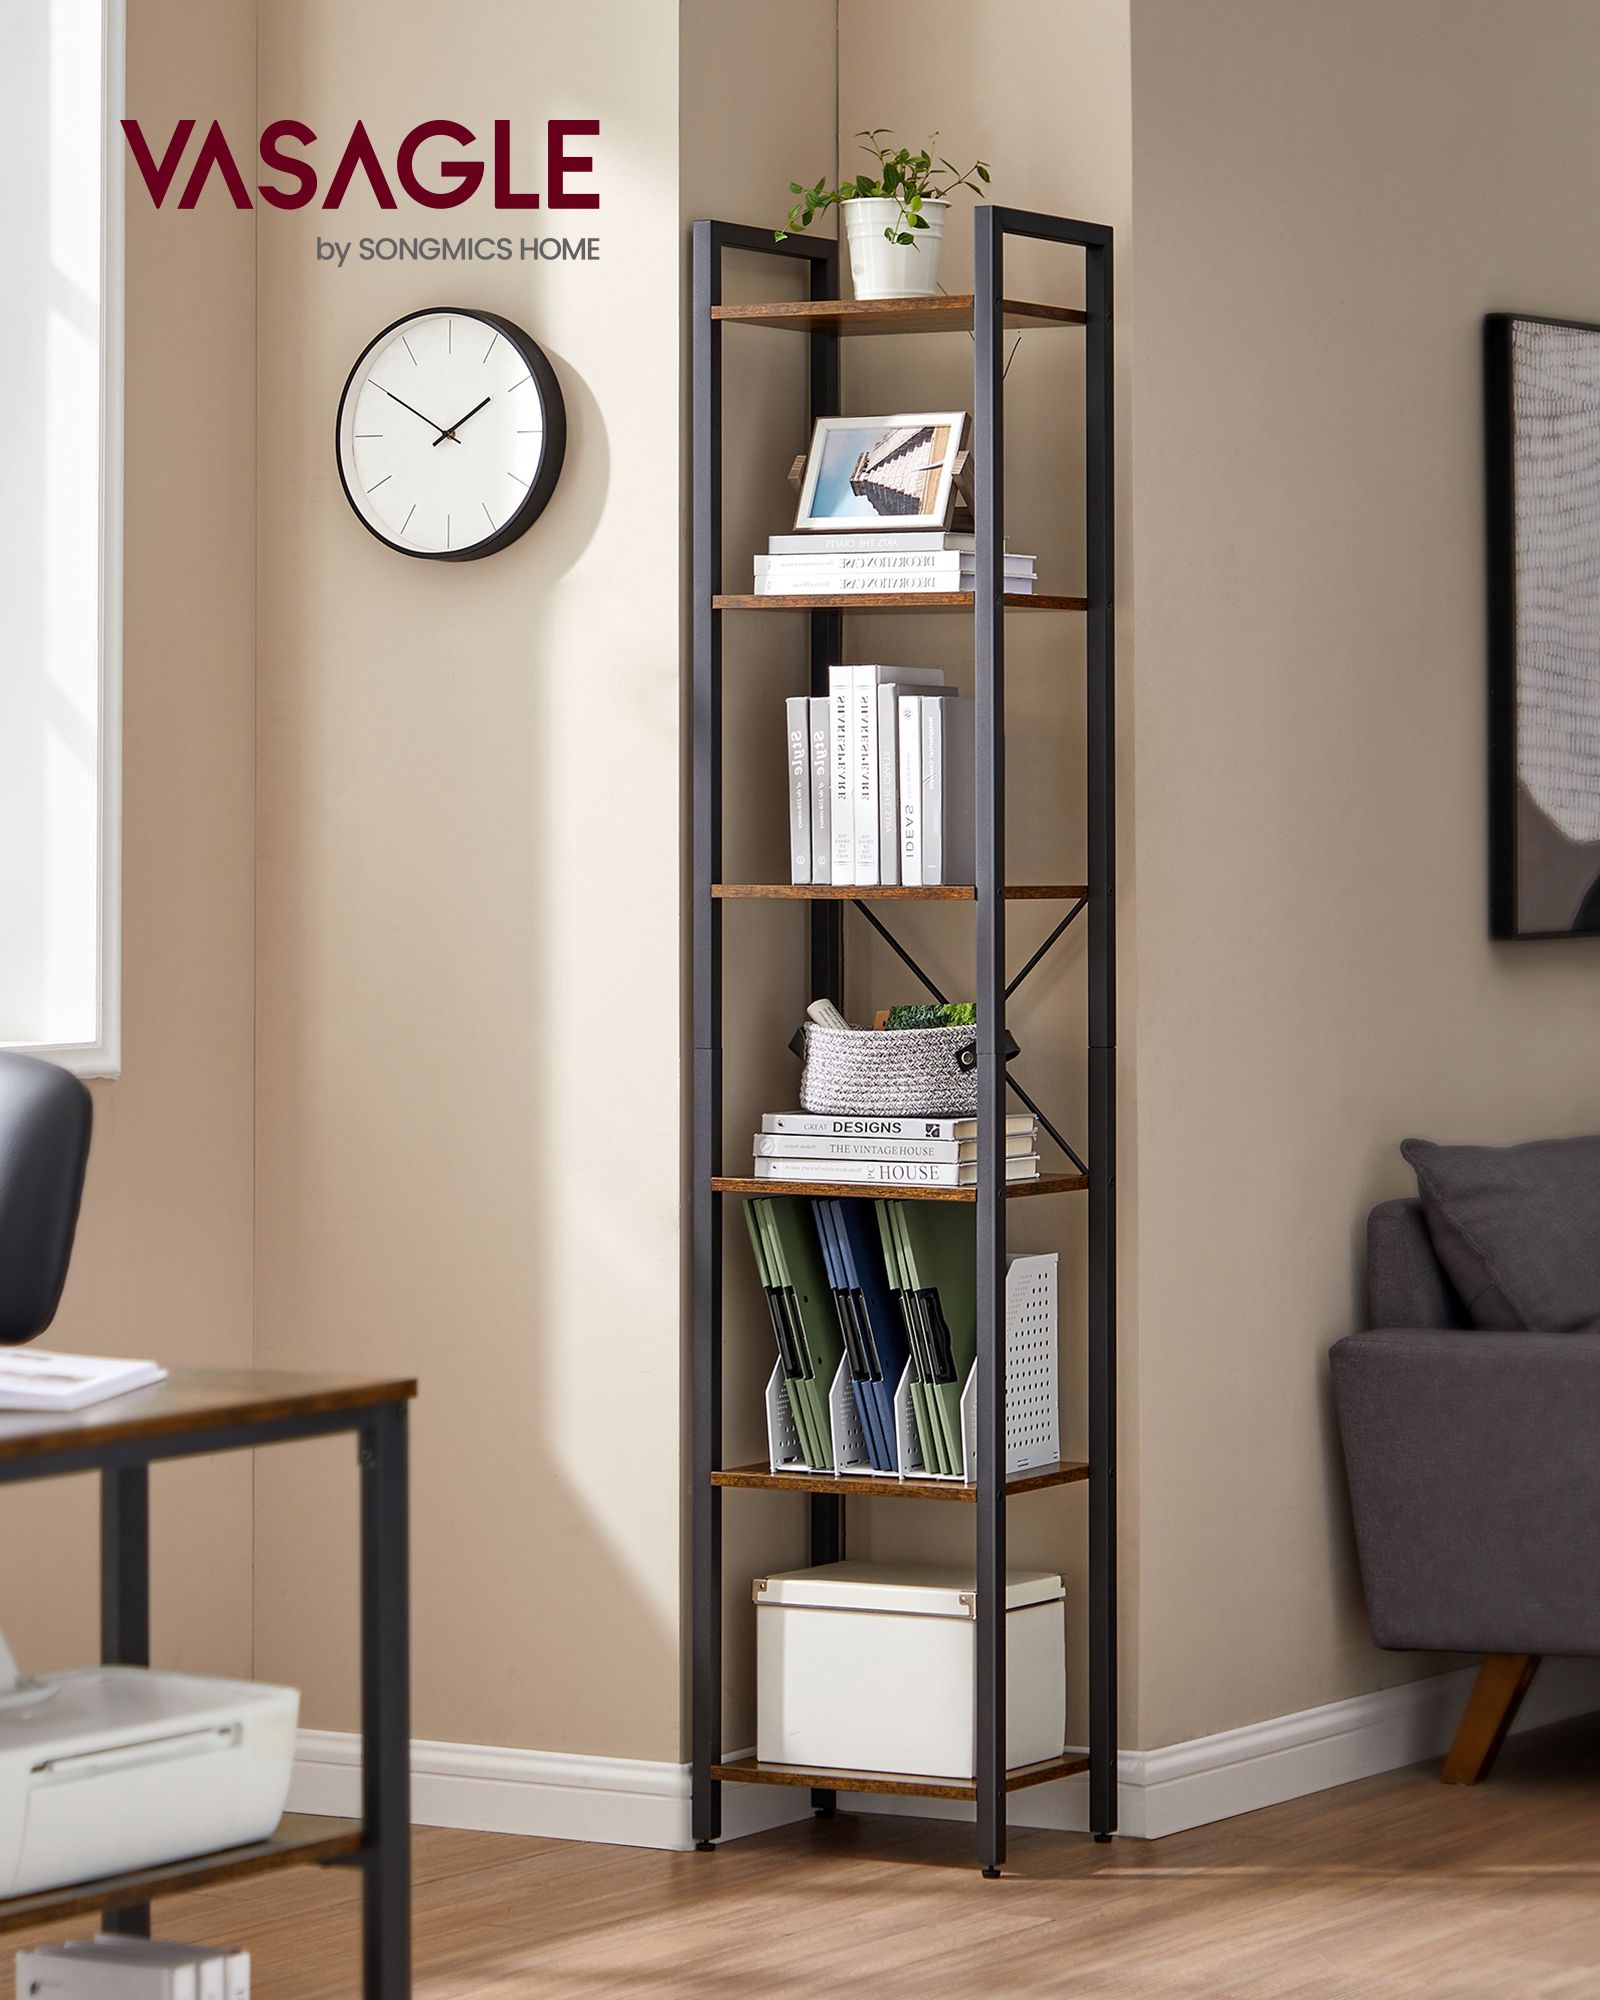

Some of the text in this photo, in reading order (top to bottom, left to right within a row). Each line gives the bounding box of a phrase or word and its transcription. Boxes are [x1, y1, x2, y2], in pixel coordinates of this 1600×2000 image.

[804, 1121, 902, 1134] GREAT DESIGNS
[830, 1144, 934, 1156] THE VINTAGE HOUSE
[880, 1165, 939, 1180] HOUSE
